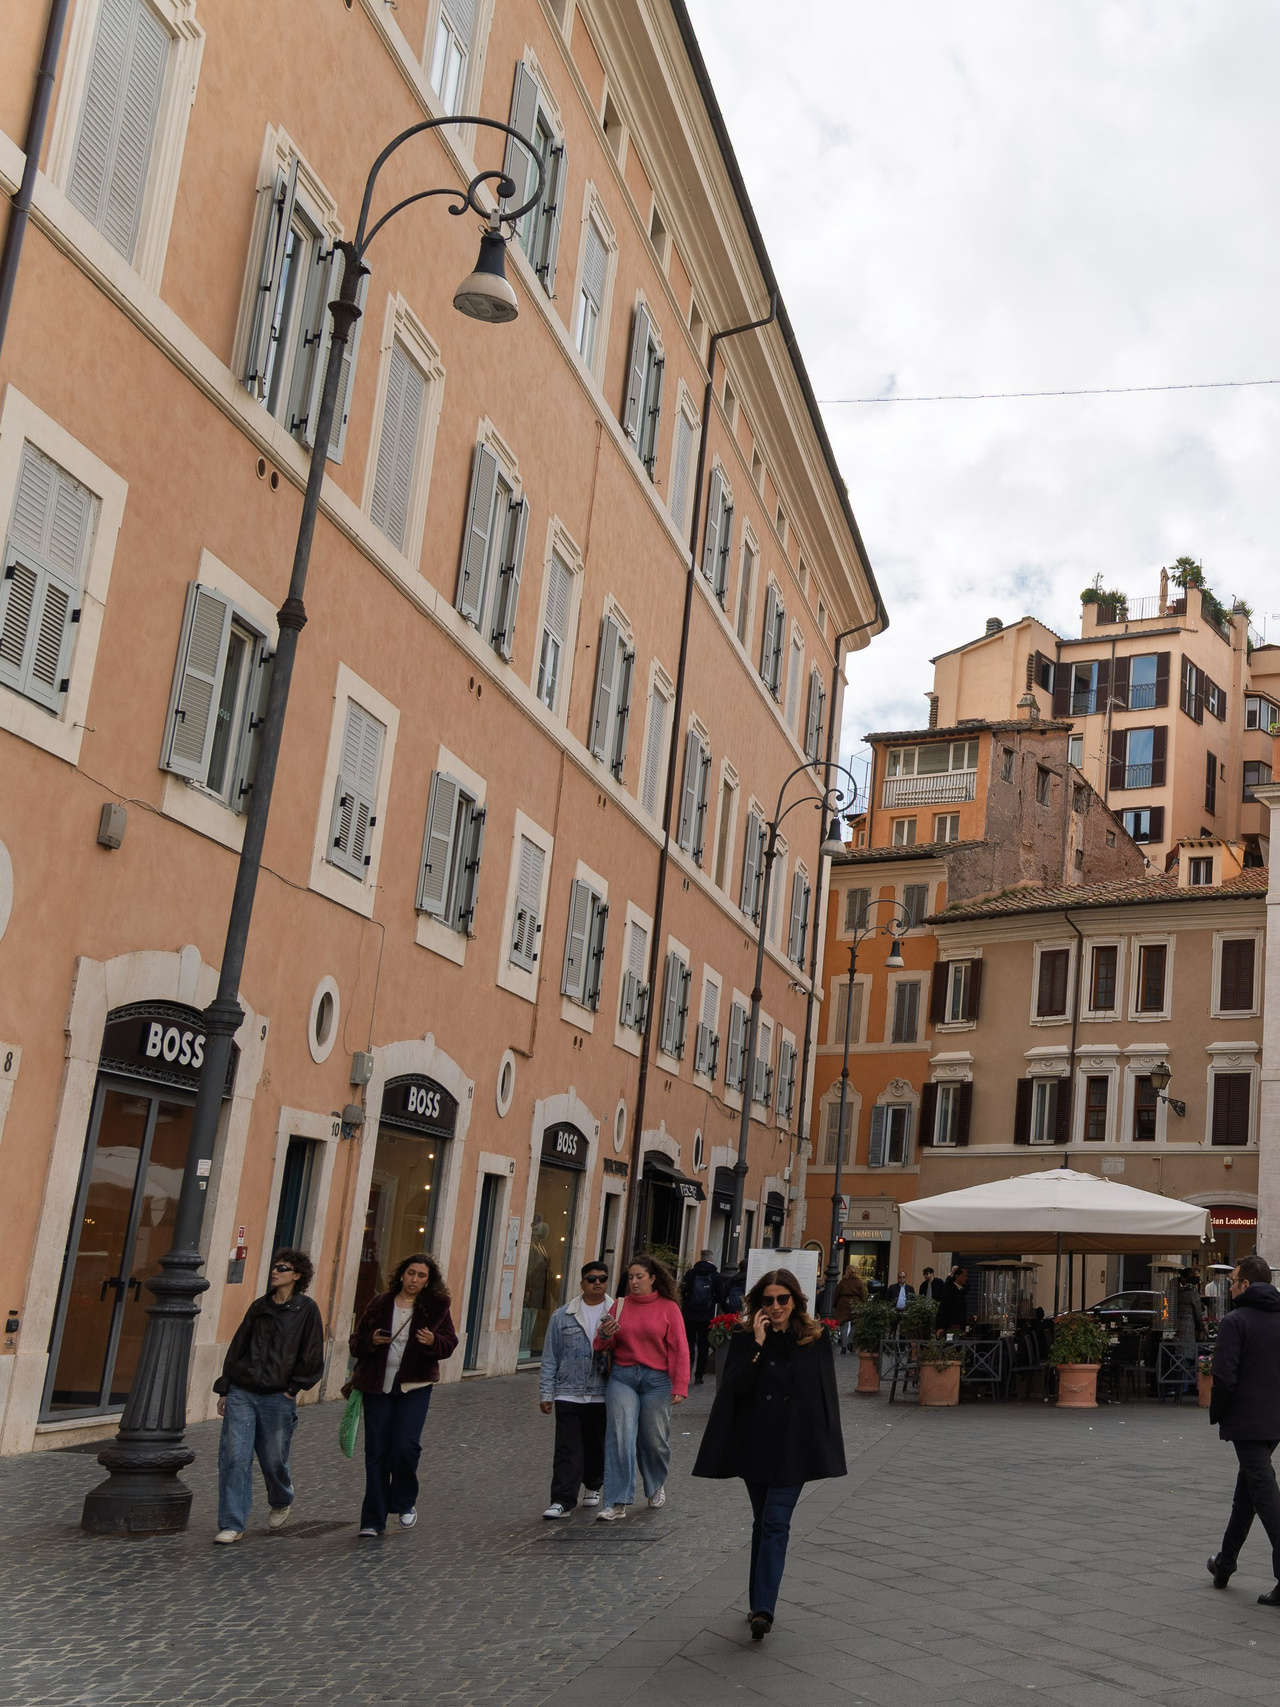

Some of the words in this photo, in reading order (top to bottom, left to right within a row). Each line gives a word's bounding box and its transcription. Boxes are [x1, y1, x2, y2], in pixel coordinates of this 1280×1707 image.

[260, 1025, 267, 1041] 9
[146, 1022, 206, 1068] BOSS
[4, 1051, 13, 1072] 8
[408, 1085, 441, 1118] BOSS
[331, 1122, 340, 1137] 10
[556, 1131, 578, 1155] BOSS
[509, 1161, 515, 1174] 12
[1225, 1217, 1258, 1225] Loubouti
